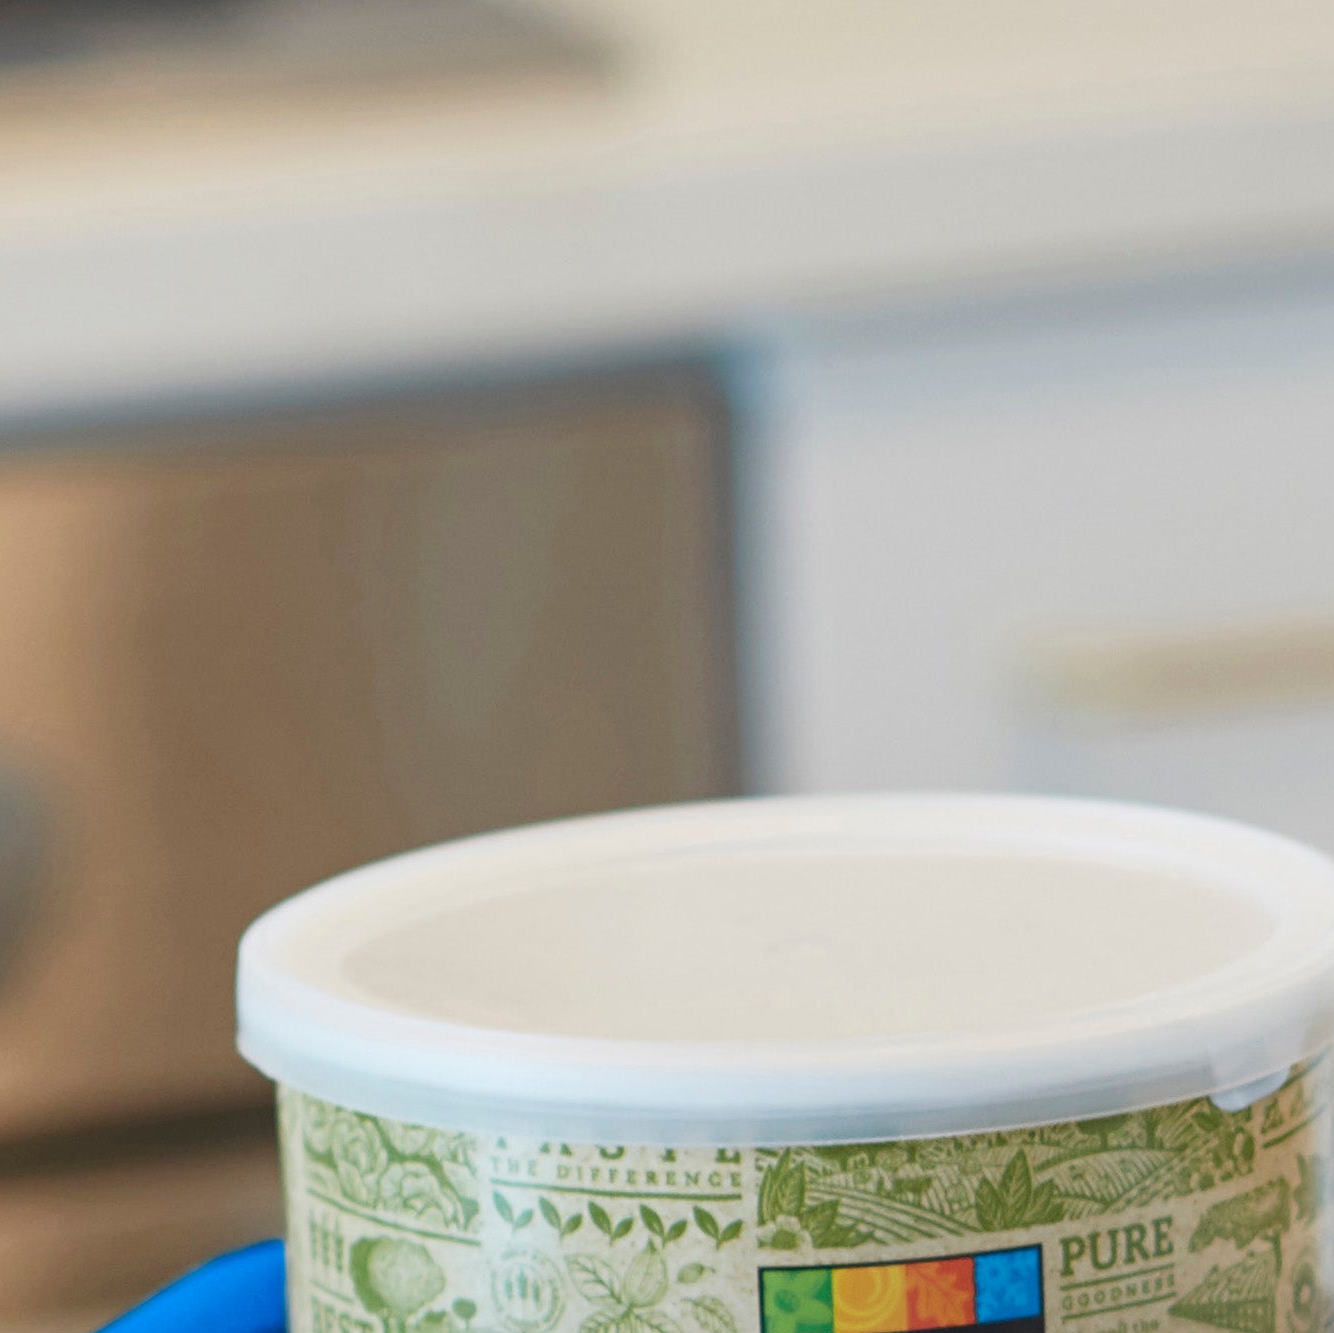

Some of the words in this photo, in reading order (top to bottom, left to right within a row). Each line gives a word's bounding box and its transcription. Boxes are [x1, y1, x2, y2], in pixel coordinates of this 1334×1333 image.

[490, 1155, 538, 1177] THE
[556, 1163, 742, 1189] DIFFERENCE
[1059, 1216, 1175, 1277] PURE
